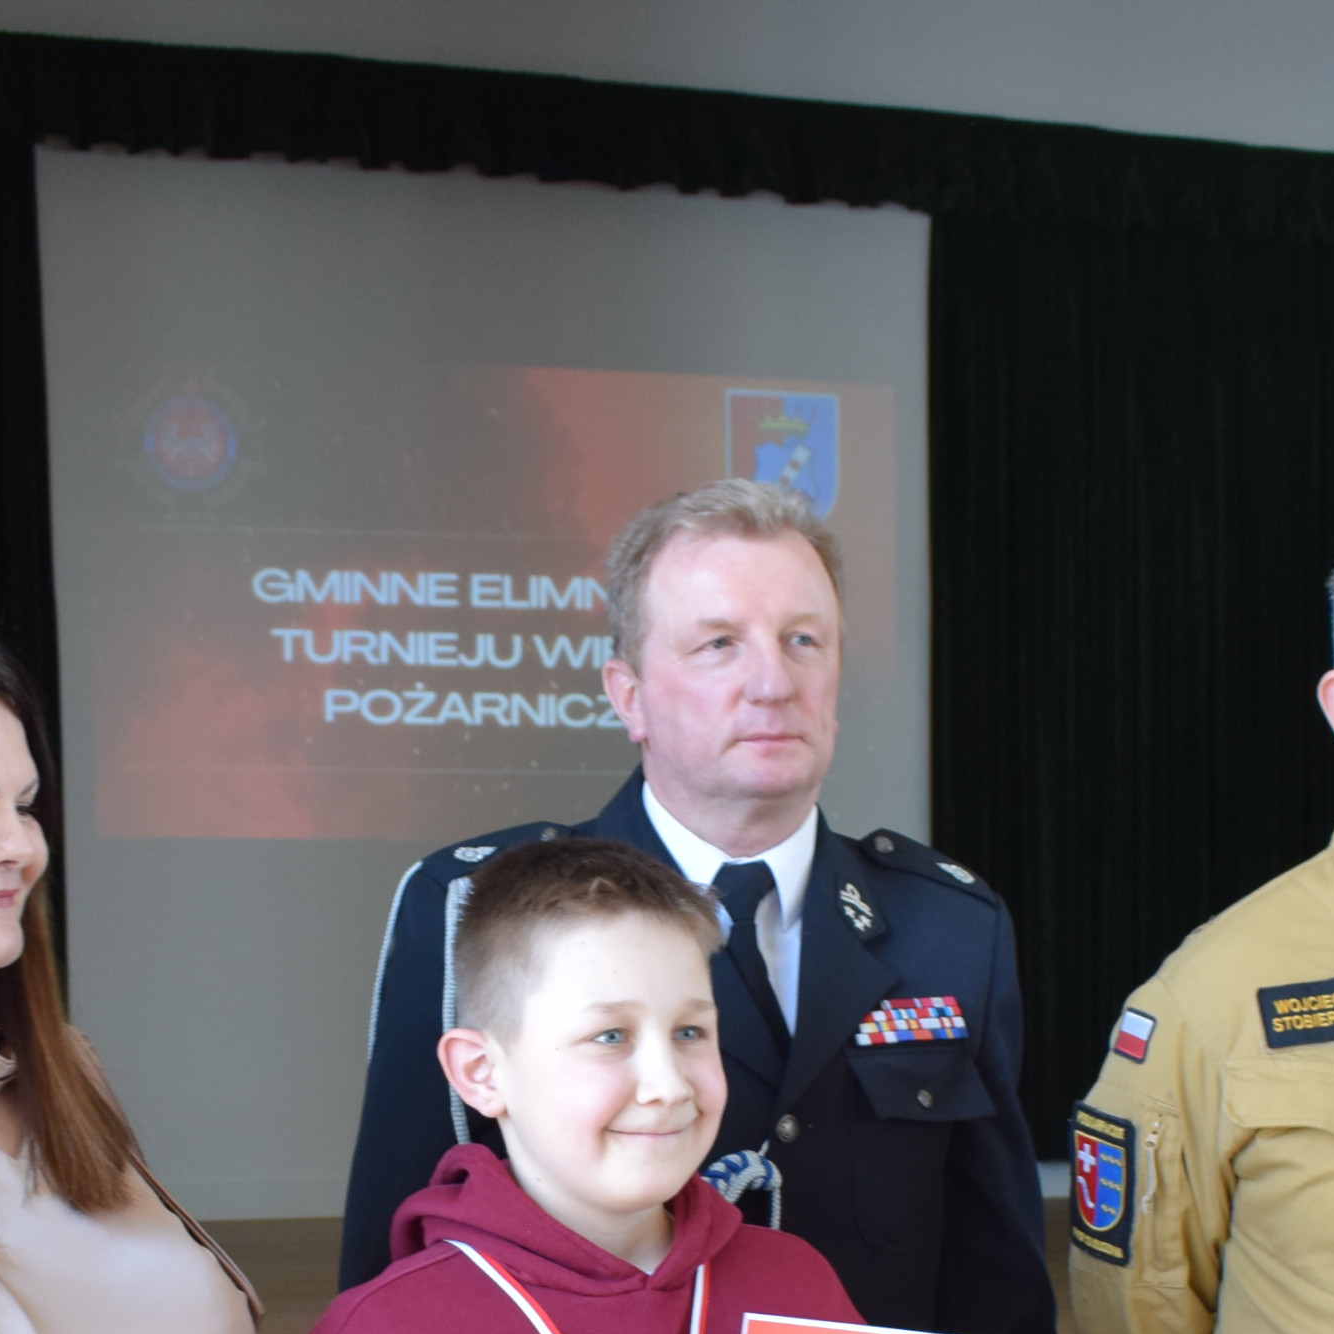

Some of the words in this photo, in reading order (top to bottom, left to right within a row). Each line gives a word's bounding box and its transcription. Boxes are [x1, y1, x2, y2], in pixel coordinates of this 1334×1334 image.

[252, 567, 459, 607] GMINNE
[470, 573, 609, 610] ELIMN
[271, 628, 522, 669] TURNIEJU
[323, 682, 625, 729] POŻARNICZ
